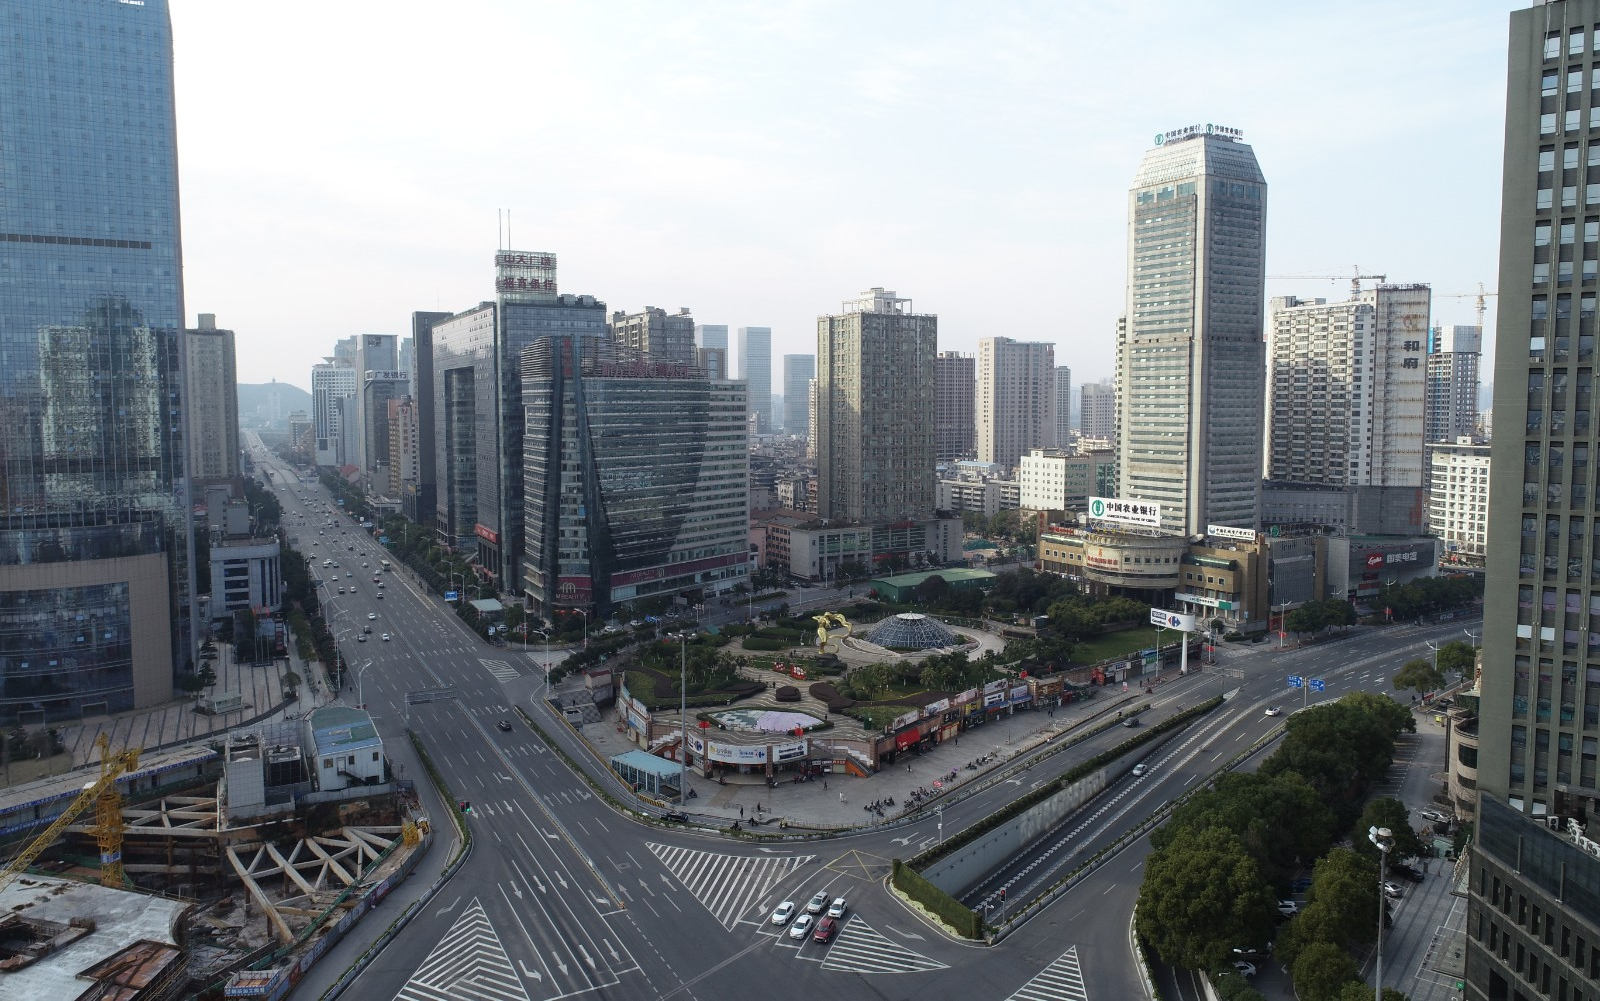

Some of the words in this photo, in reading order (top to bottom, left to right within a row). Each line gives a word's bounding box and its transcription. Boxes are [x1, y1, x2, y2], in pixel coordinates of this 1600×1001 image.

[503, 276, 553, 290] 招商银行
[1403, 341, 1419, 369] 和府
[375, 371, 407, 379] 广发银行
[1106, 502, 1157, 516] 中国农业银行
